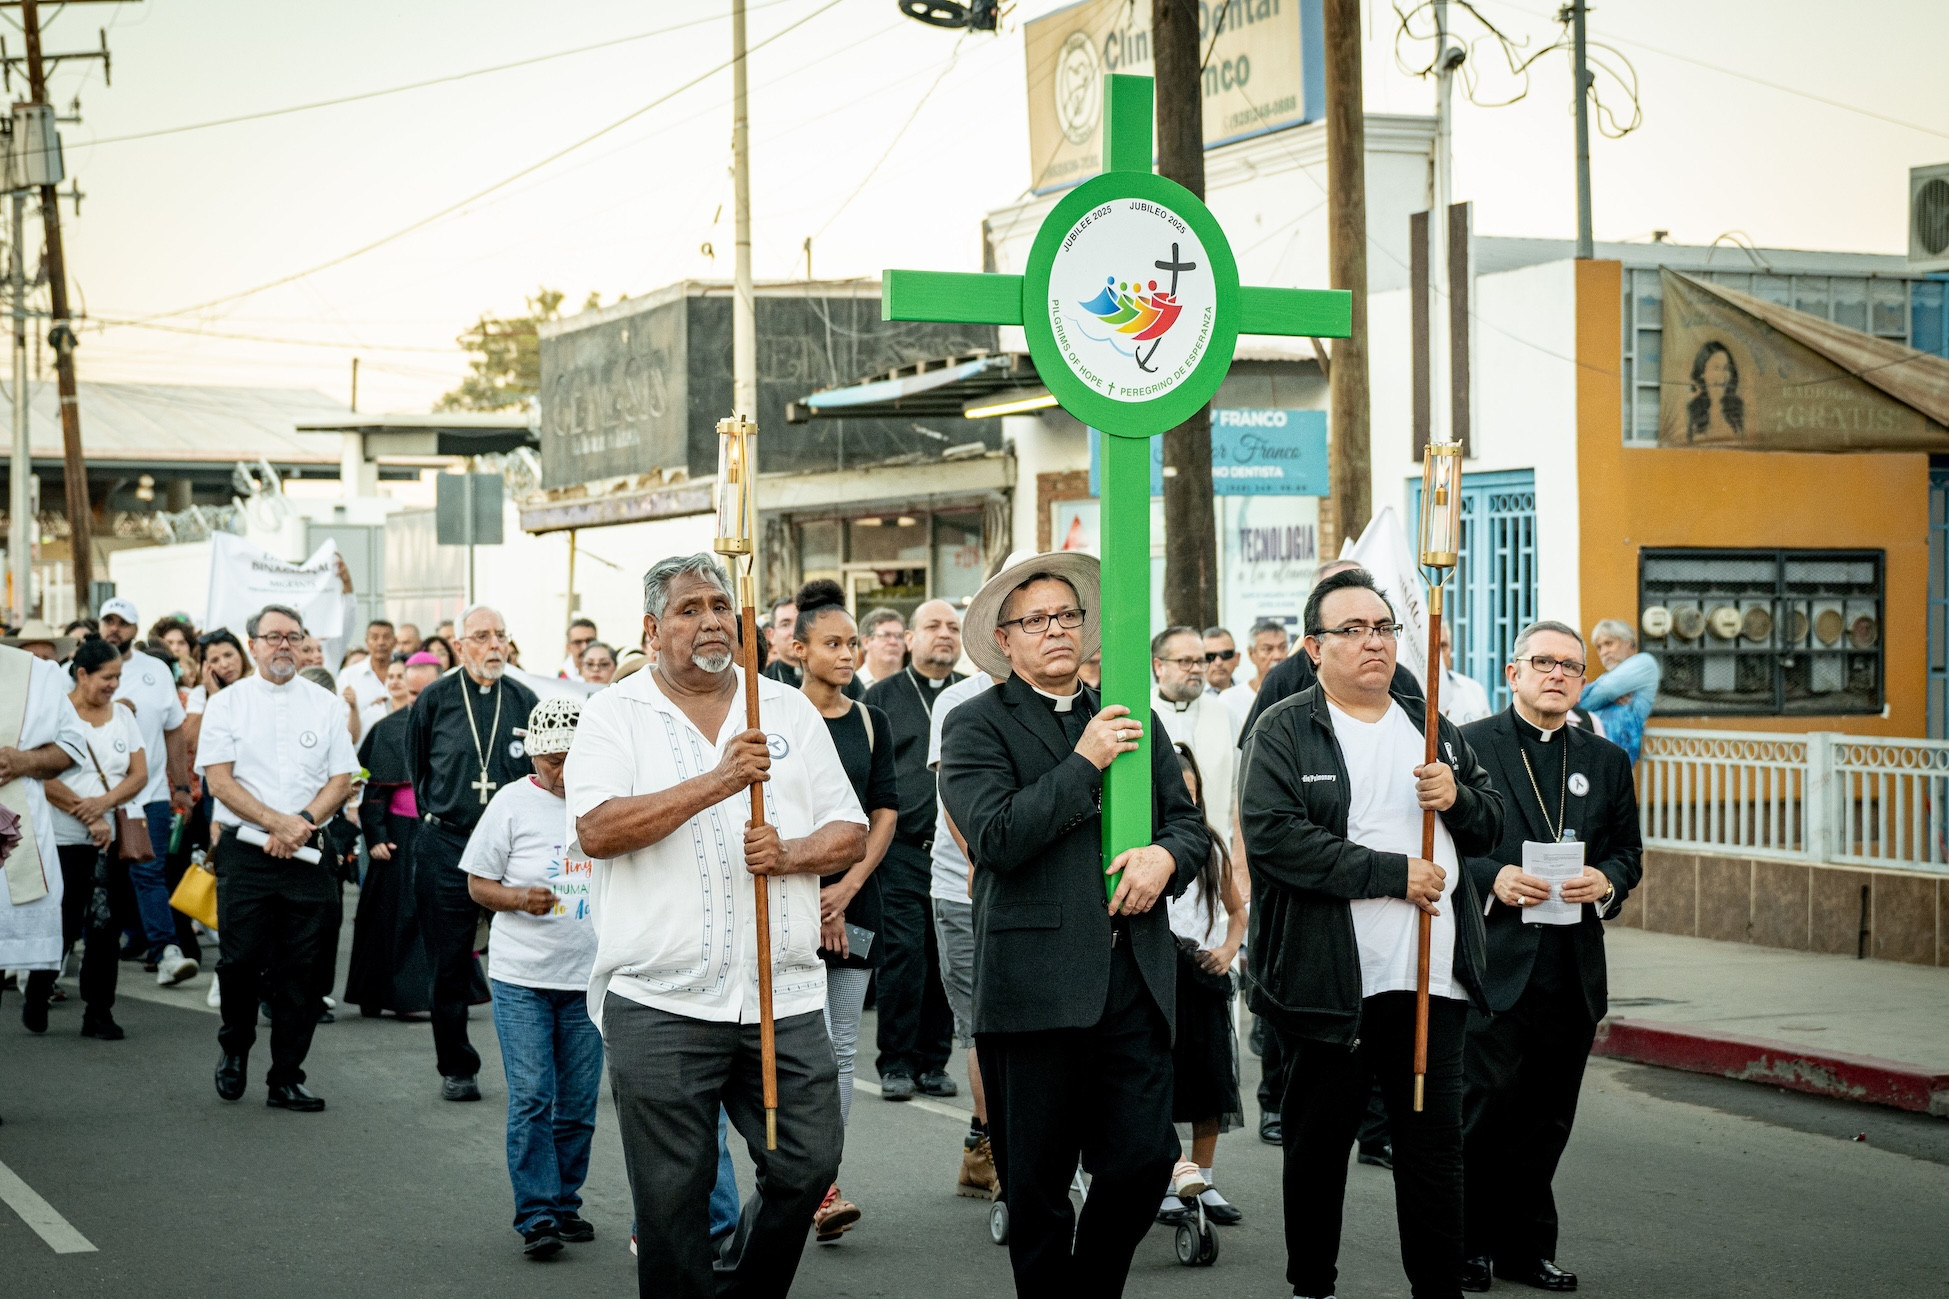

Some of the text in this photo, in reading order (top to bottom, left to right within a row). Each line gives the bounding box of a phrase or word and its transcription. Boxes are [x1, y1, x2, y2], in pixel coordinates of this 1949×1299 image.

[1104, 22, 1148, 71] Clín
[1203, 53, 1251, 97] nco
[1063, 205, 1112, 252] JUBILEE 2025
[1129, 201, 1186, 234] JUBILEO 2025
[1052, 299, 1103, 387] PILGRIMS OF HOPE
[1120, 306, 1211, 397] PEREGRINO DE ESPERANZA
[1220, 410, 1288, 428] FRANCO
[1231, 433, 1301, 465] Franco
[1230, 465, 1285, 479] DENTISTA
[563, 857, 593, 878] Tiny
[553, 883, 591, 895] HUMA
